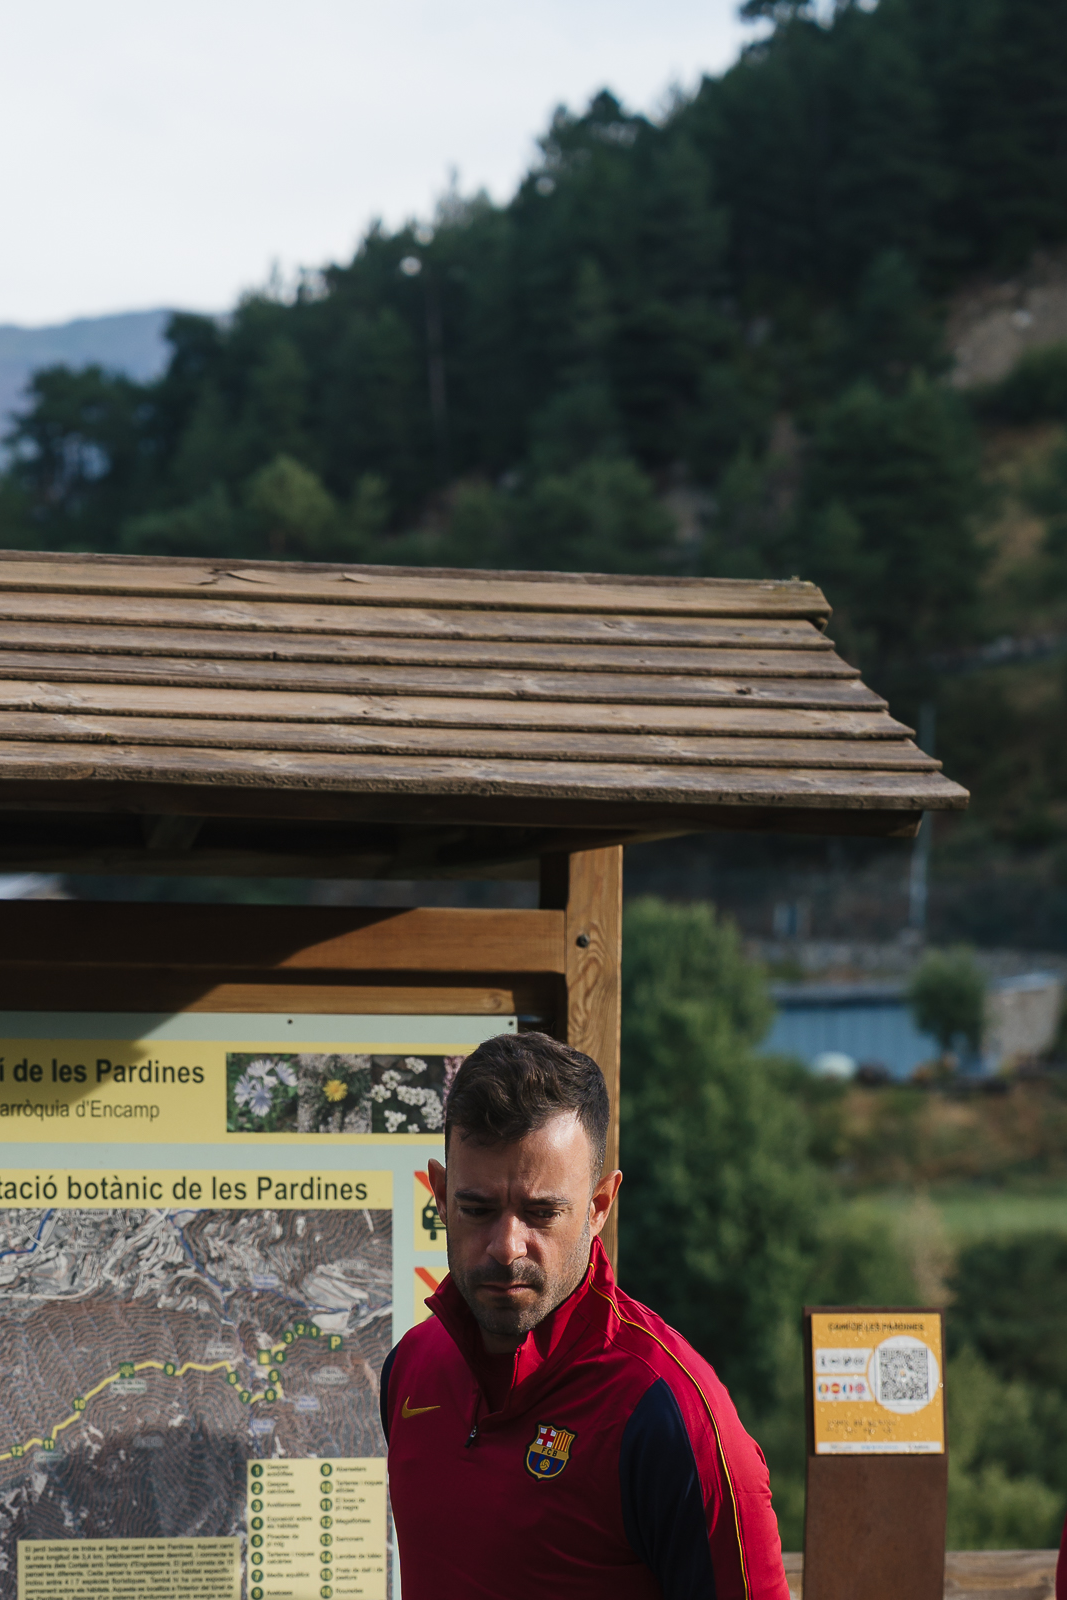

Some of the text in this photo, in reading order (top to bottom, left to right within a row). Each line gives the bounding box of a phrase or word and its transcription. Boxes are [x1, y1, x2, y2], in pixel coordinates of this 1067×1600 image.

[13, 1058, 43, 1083] de
[52, 1058, 87, 1084] les
[96, 1059, 205, 1084] Pardines
[76, 1100, 159, 1122] d'Encamp
[67, 1175, 162, 1200] botànic
[172, 1176, 202, 1200] de
[212, 1176, 247, 1200] les
[257, 1177, 367, 1201] Pardines
[541, 1446, 558, 1457] FCB
